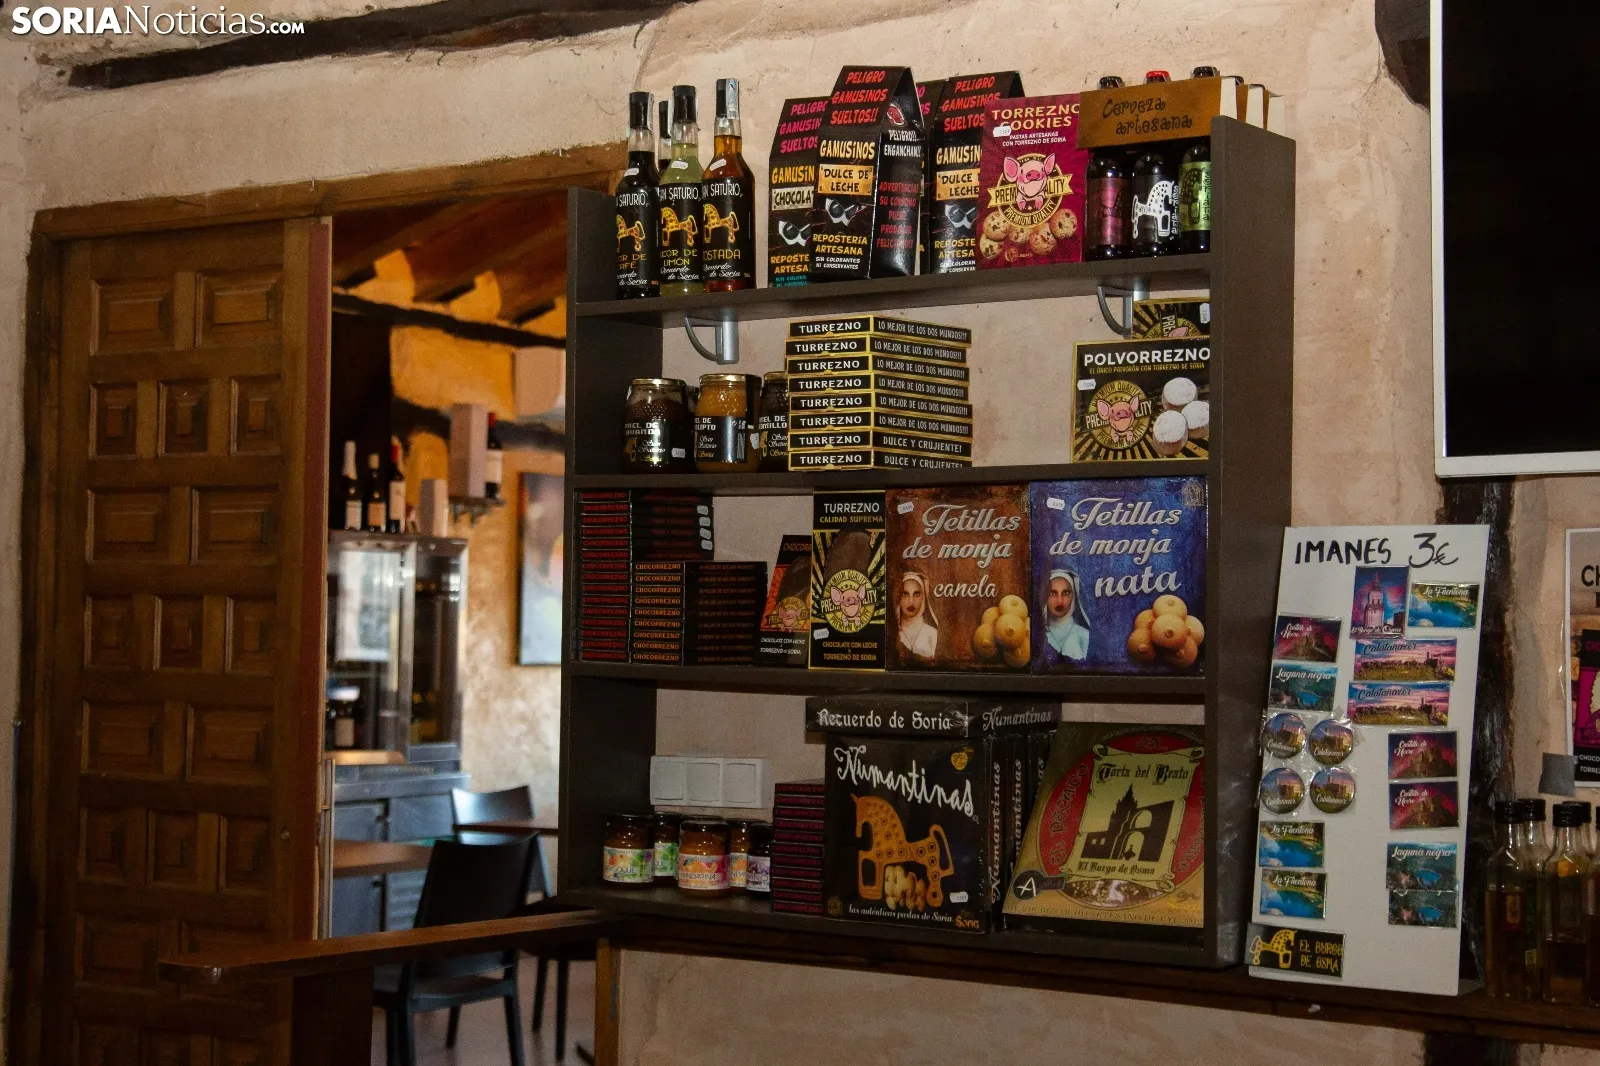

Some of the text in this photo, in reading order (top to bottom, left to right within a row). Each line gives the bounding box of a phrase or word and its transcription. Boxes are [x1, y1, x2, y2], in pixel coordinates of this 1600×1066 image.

[847, 71, 886, 85] PELIGRO
[954, 76, 996, 92] PELIGRO
[1102, 98, 1166, 119] Cerveza
[1115, 114, 1193, 135] artesana
[824, 168, 869, 180] DULCE DE
[942, 173, 973, 184] DULCE
[669, 187, 699, 200] SATURIO
[710, 183, 741, 197] SATURIO
[831, 182, 860, 193] LECHE
[949, 186, 980, 198] LECHE
[683, 249, 698, 257] DE
[815, 244, 864, 256] ARTESANA
[799, 321, 861, 334] TURREZNO
[878, 320, 886, 330] LO
[887, 321, 906, 332] MEJOR
[907, 325, 915, 333] DE
[916, 325, 926, 335] LOS
[795, 341, 857, 353] TURREZNO
[874, 341, 881, 349] LO
[883, 341, 902, 352] MEJOR
[903, 344, 911, 353] DE
[912, 346, 922, 355] LOS
[1084, 347, 1210, 367] POLVORREZNO
[797, 360, 860, 372] TURREZNO
[877, 359, 884, 368] LO
[885, 360, 904, 371] MEJOR
[906, 363, 913, 372] DE
[915, 364, 925, 373] LOS
[798, 379, 862, 390] TURREZNO
[878, 378, 886, 386] LO
[887, 379, 906, 389] MEJOR
[906, 382, 913, 390] DE
[915, 383, 924, 392] LOS
[800, 397, 863, 409] TURREZNO
[799, 416, 862, 427] TURREZNO
[799, 435, 861, 446] TURREZNO
[883, 436, 962, 453] DULCE Y CRUJIENTE!
[800, 454, 863, 465] TURREZNO
[884, 455, 909, 466] DULCE
[911, 458, 917, 467] Y
[823, 502, 880, 514] TURREZNO
[1071, 497, 1183, 531] Tetillas
[849, 515, 884, 523] SUPREMA
[922, 503, 1021, 536] Tetillas
[901, 534, 1013, 568] de monja
[1049, 528, 1172, 565] de monja
[1294, 532, 1459, 569] IMANES 3€
[933, 574, 998, 599] canela
[1094, 566, 1182, 599] nata
[822, 641, 850, 649] CHOCOLATE
[823, 653, 852, 661] TORREZNO
[860, 653, 877, 661] SORIA
[1276, 669, 1333, 682] Laguna negra
[817, 708, 953, 730] Recuerdo de Soria
[981, 707, 1053, 731] Numantinas
[1134, 764, 1149, 778] del
[833, 745, 975, 818] Numantinas
[1392, 846, 1452, 860] Laguna negra
[1118, 865, 1127, 874] de
[896, 909, 920, 921] pastas
[921, 912, 929, 921] de
[1299, 940, 1310, 952] EL
[1300, 956, 1339, 973] DE OSMA
